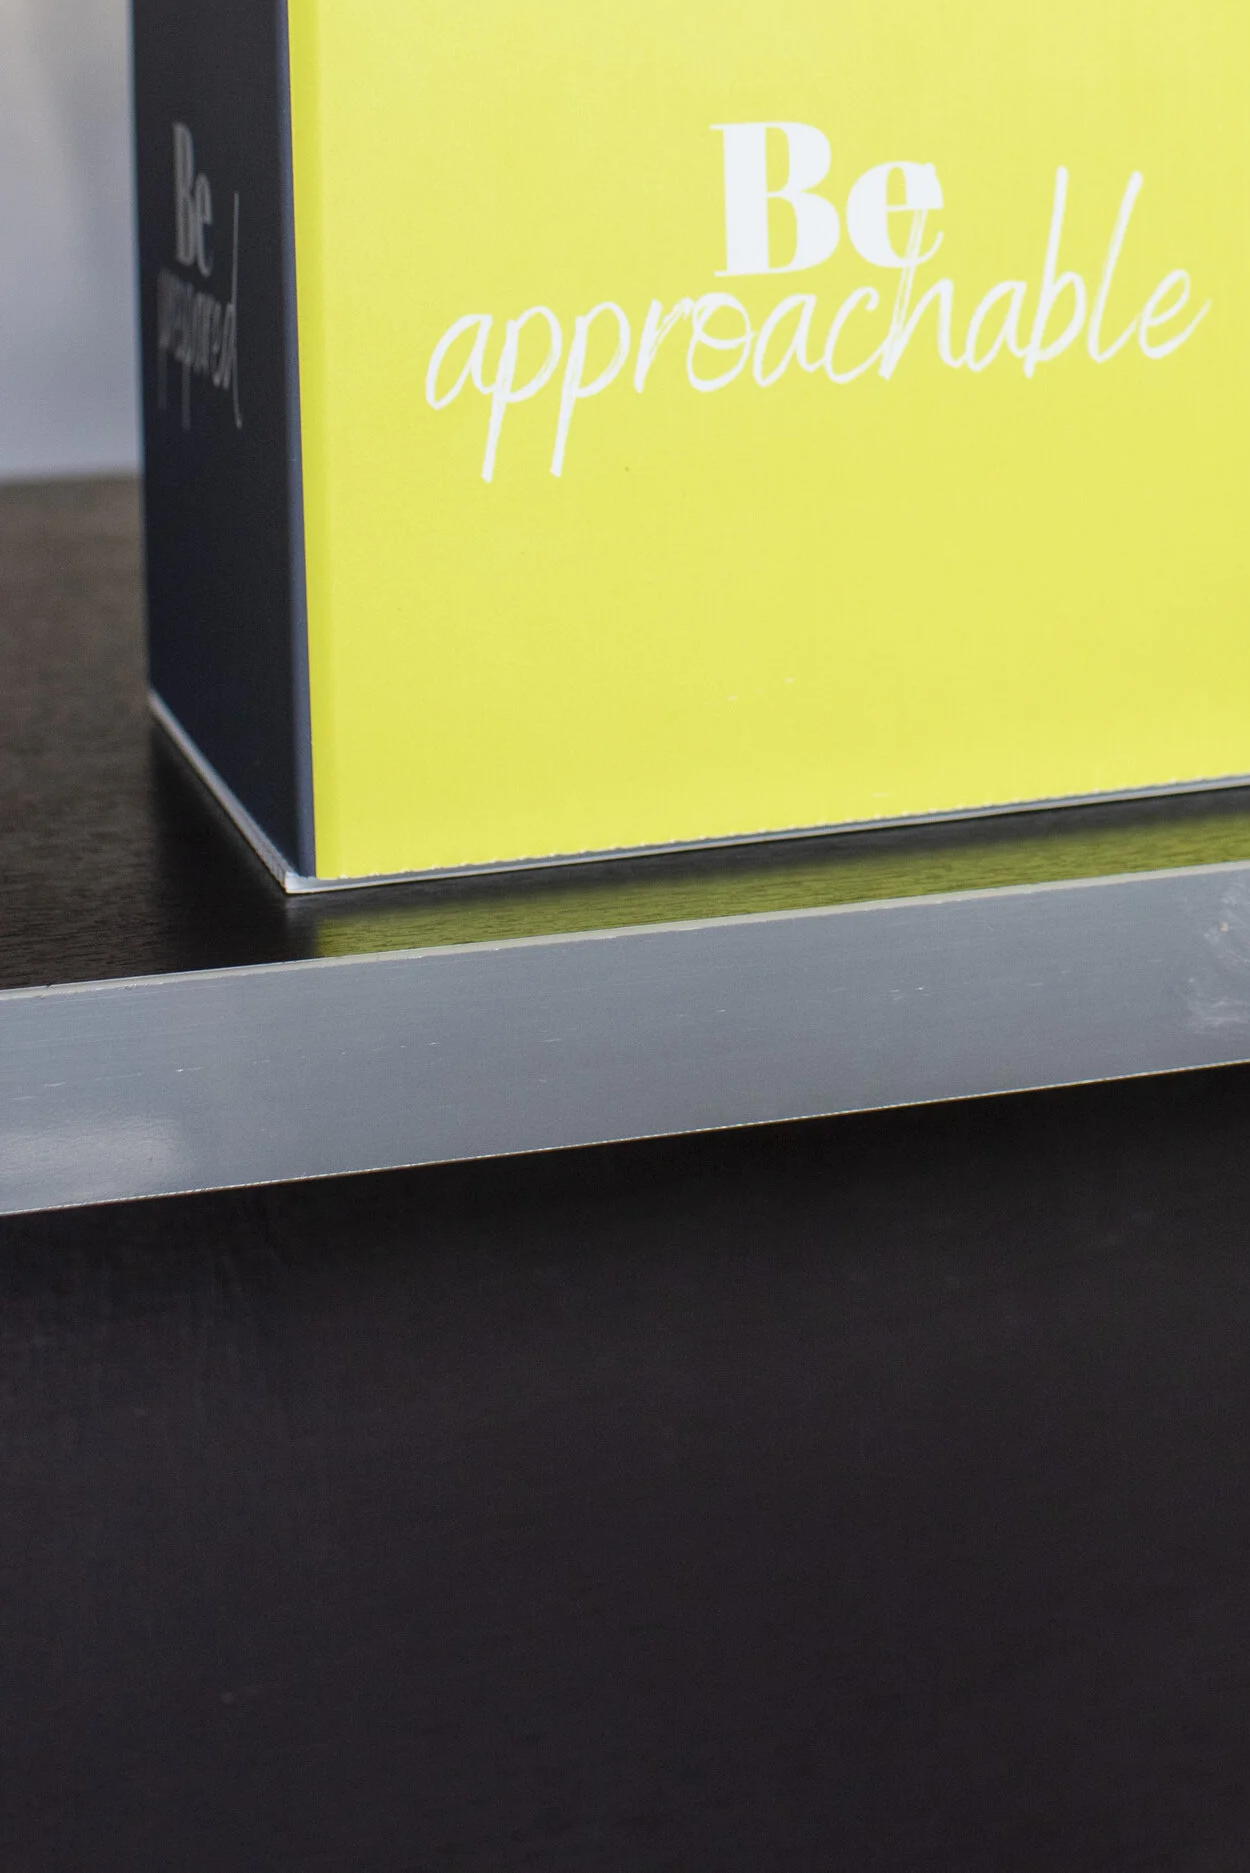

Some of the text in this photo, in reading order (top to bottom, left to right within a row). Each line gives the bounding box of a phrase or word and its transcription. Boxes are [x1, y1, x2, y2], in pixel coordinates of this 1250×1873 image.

[173, 121, 214, 277] Be
[711, 121, 944, 278] Be
[425, 165, 1211, 483] approachable
